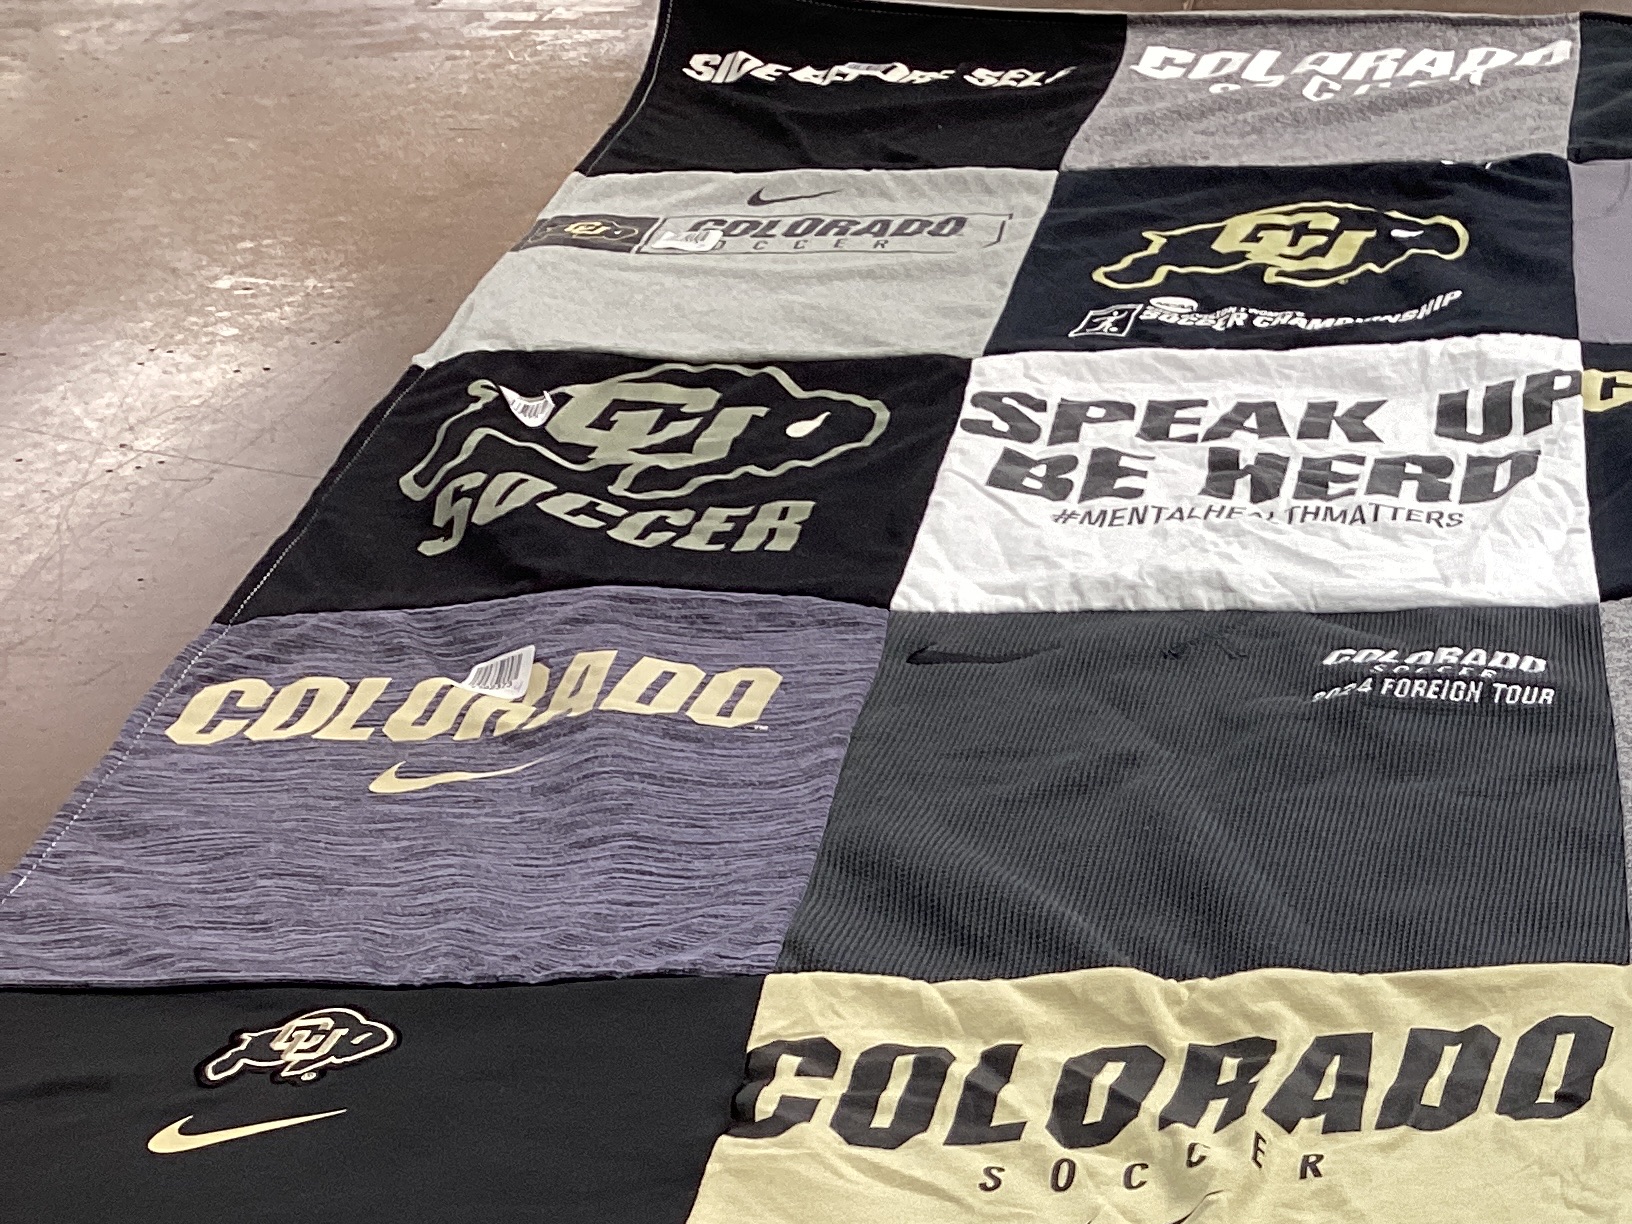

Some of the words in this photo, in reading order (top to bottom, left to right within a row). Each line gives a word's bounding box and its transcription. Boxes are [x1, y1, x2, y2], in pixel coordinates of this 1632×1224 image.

[682, 51, 792, 84] SIDE
[1130, 40, 1572, 86] COLORADO
[688, 216, 968, 238] COLORADO
[714, 237, 890, 251] OCCER
[959, 390, 1389, 445] SPEAK
[1433, 369, 1582, 443] UP
[984, 445, 1156, 504] BE
[1199, 446, 1541, 504] HERD
[416, 472, 816, 557] SOCCER
[1322, 646, 1547, 674] COLORADO
[1368, 663, 1498, 679] SOCCER
[164, 649, 783, 746] COLORADO
[1311, 677, 1373, 703] 2024
[1380, 677, 1483, 704] FOREIGN
[1491, 682, 1556, 705] TOUR
[720, 1014, 1615, 1150] COLORADO
[978, 1129, 1325, 1194] SOCCER
